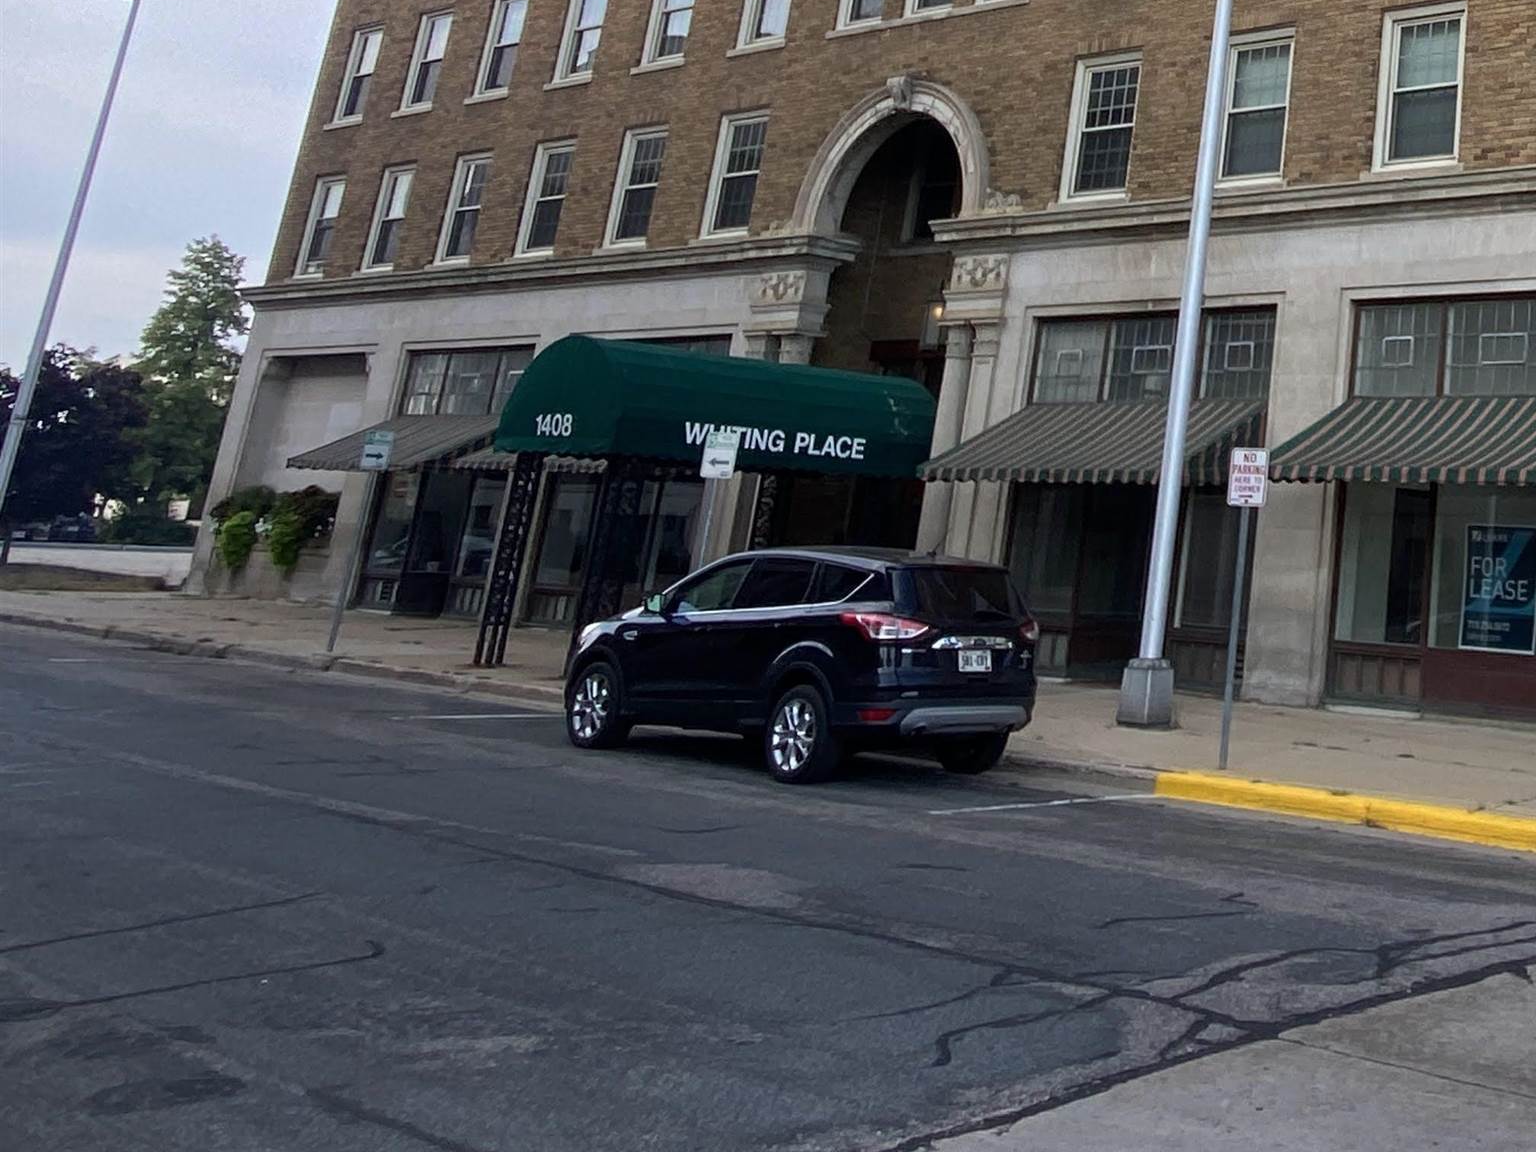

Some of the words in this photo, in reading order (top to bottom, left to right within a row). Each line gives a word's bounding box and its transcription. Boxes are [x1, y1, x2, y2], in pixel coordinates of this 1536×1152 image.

[535, 413, 573, 437] 1408
[793, 435, 866, 460] PLACE
[1243, 452, 1257, 463] NO
[1232, 464, 1265, 475] PARKING
[1471, 556, 1507, 578] FOR
[1469, 578, 1529, 601] LEASE
